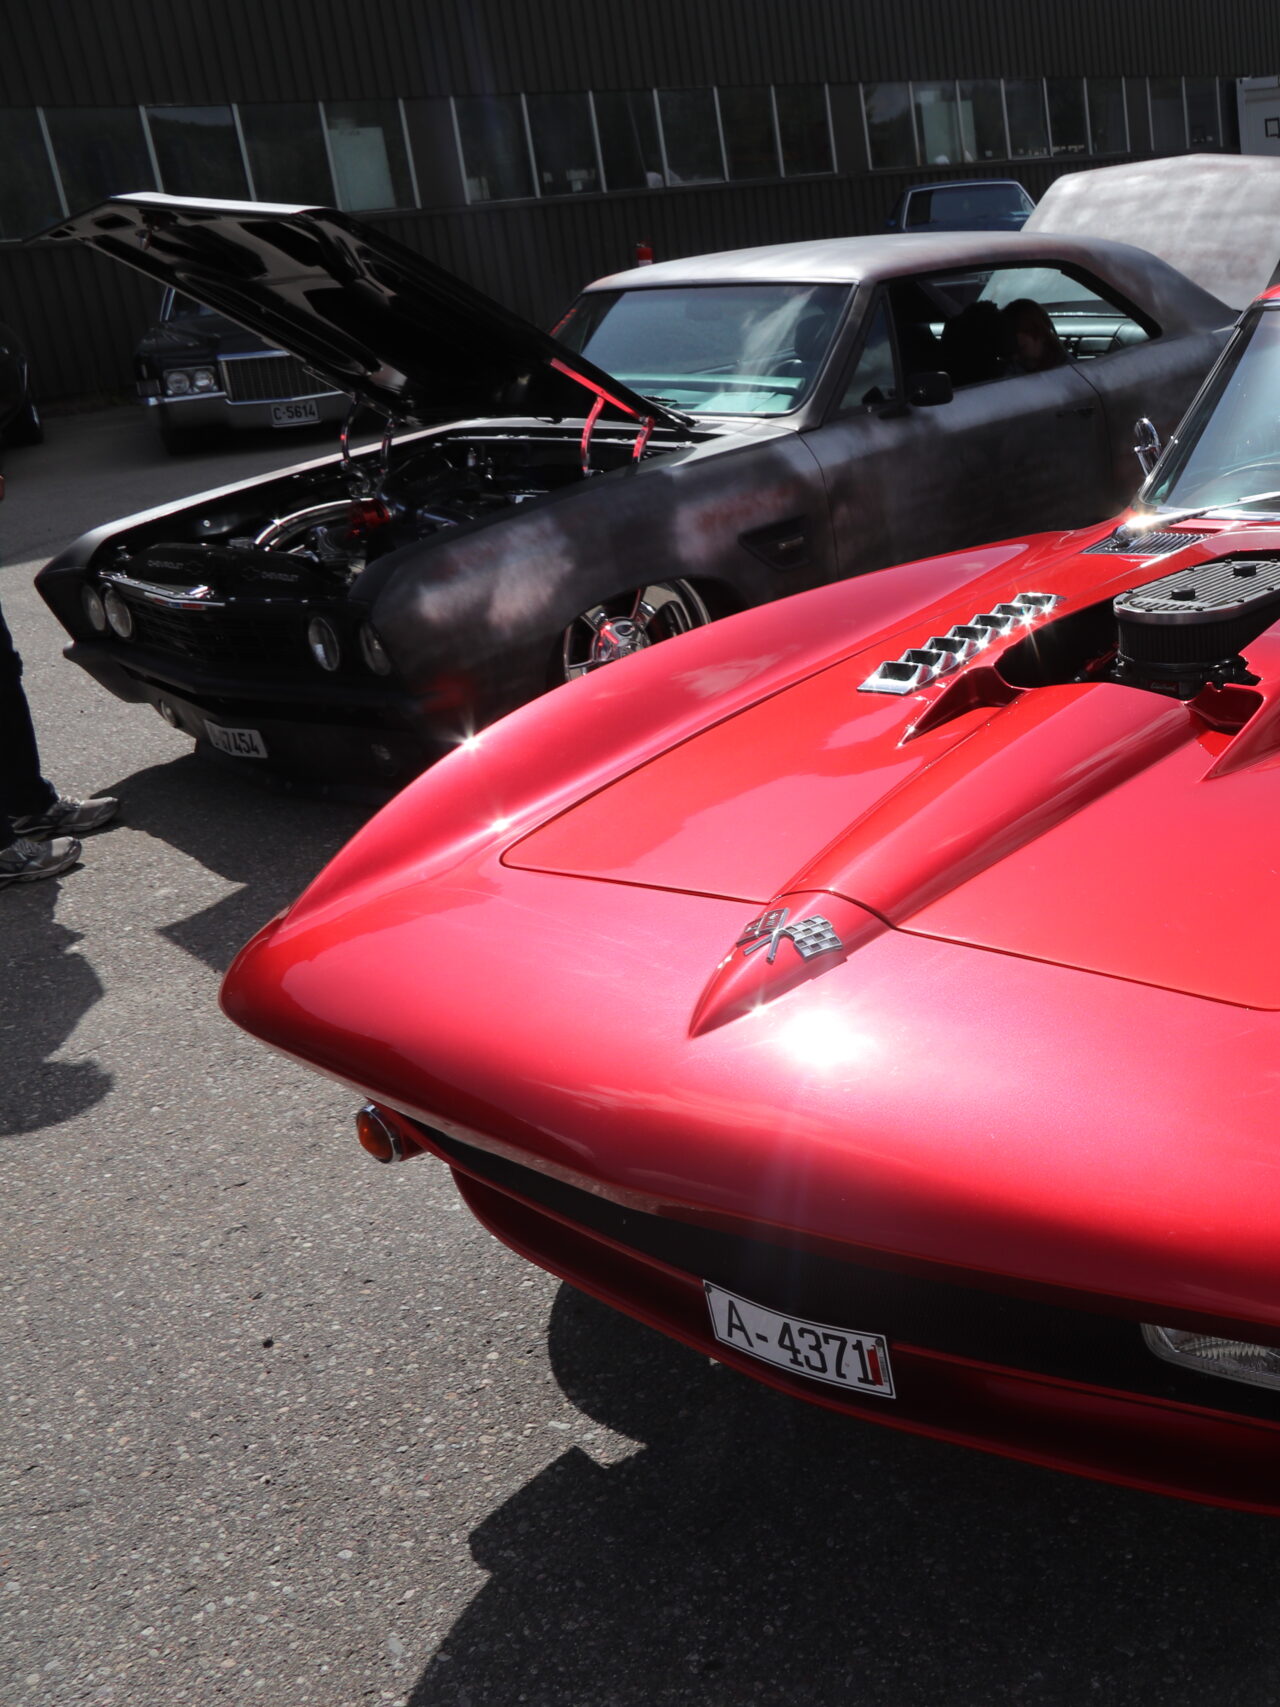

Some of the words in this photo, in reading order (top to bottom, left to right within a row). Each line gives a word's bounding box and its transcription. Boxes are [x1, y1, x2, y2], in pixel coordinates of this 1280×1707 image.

[147, 560, 184, 570] CHEVROLET
[261, 571, 299, 582] CHEVROLET
[727, 1299, 876, 1386] A-4371
